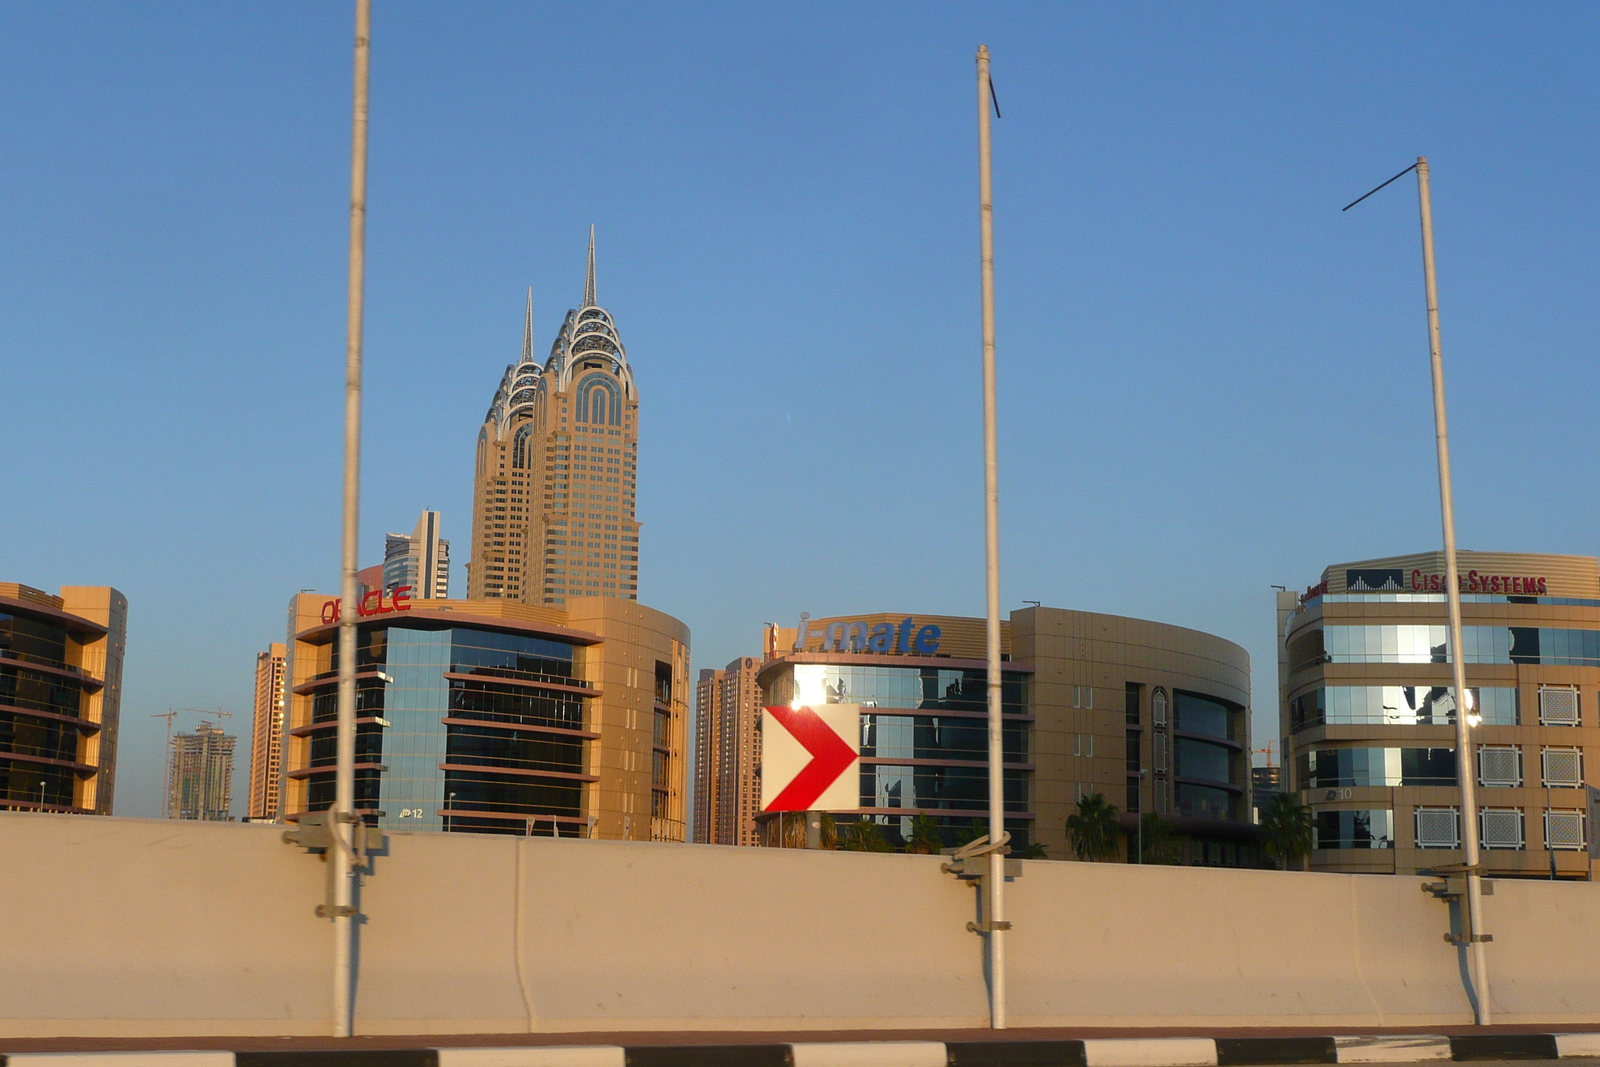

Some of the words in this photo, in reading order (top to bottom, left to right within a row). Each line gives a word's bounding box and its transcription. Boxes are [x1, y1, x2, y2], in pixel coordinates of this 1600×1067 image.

[1468, 569, 1547, 595] SYSTEMS
[796, 611, 942, 653] i-mate
[1339, 788, 1352, 800] 10
